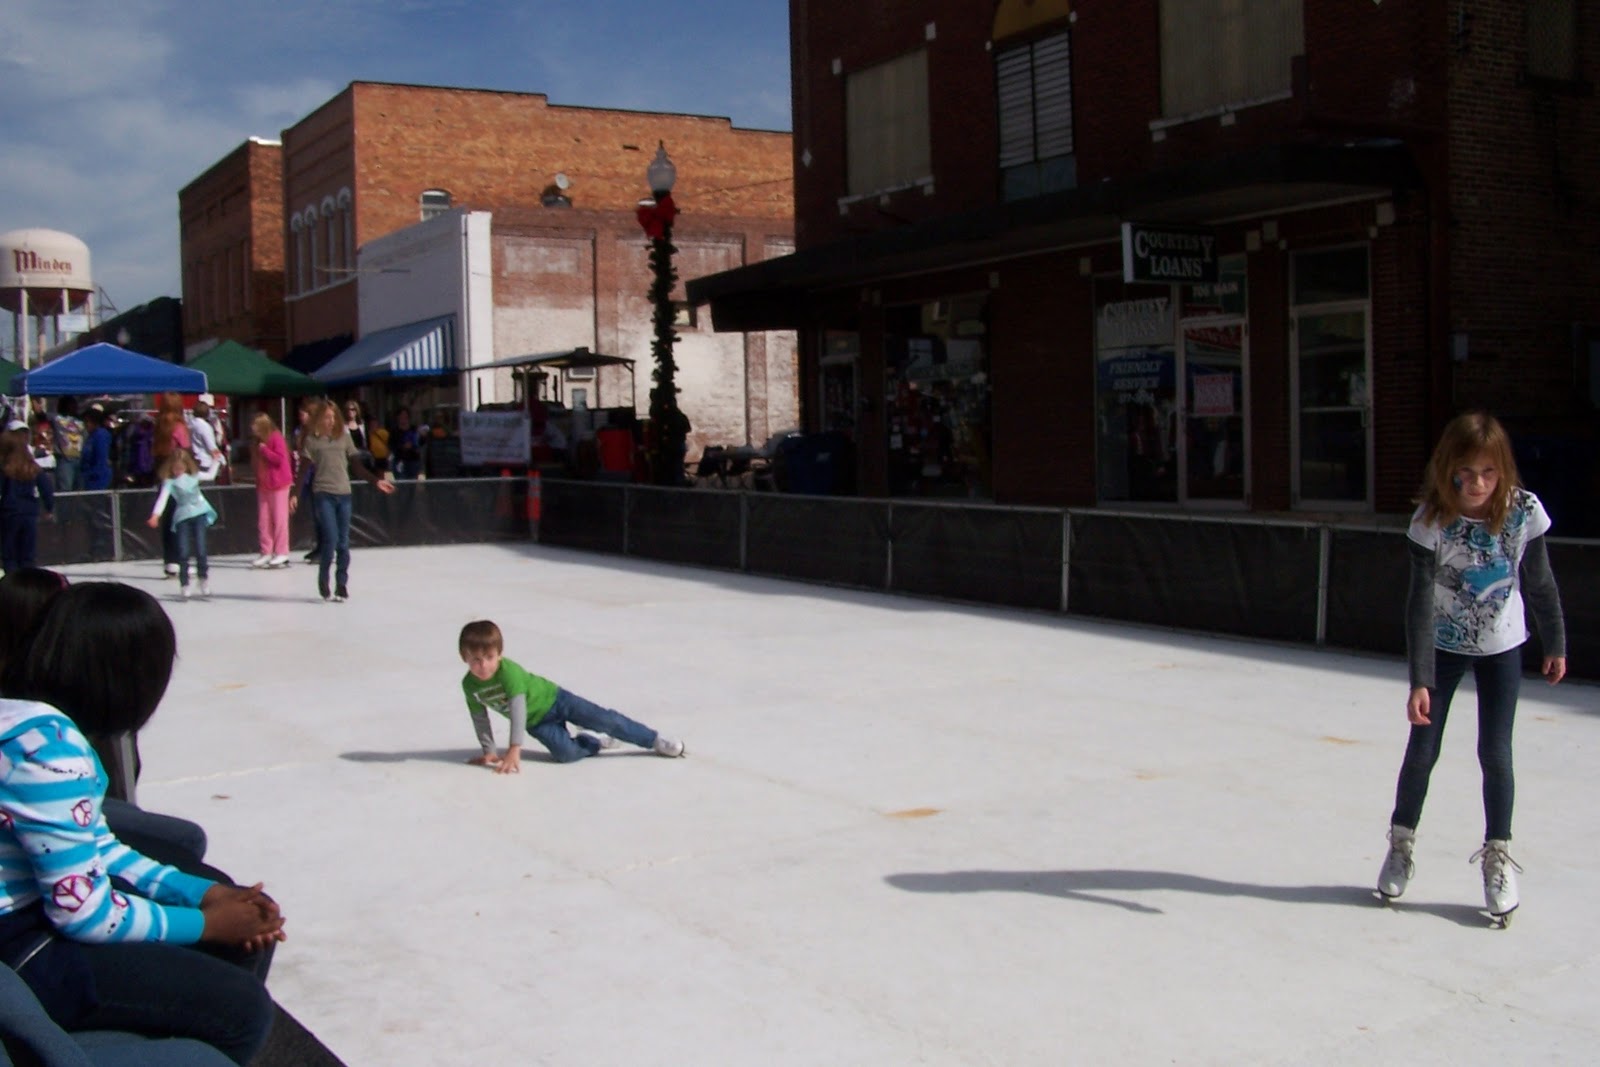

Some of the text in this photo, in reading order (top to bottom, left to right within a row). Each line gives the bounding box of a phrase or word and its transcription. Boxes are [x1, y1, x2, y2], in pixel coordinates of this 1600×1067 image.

[1134, 230, 1215, 262] COURTESY
[13, 249, 72, 273] Minden
[1150, 256, 1203, 278] LOANS
